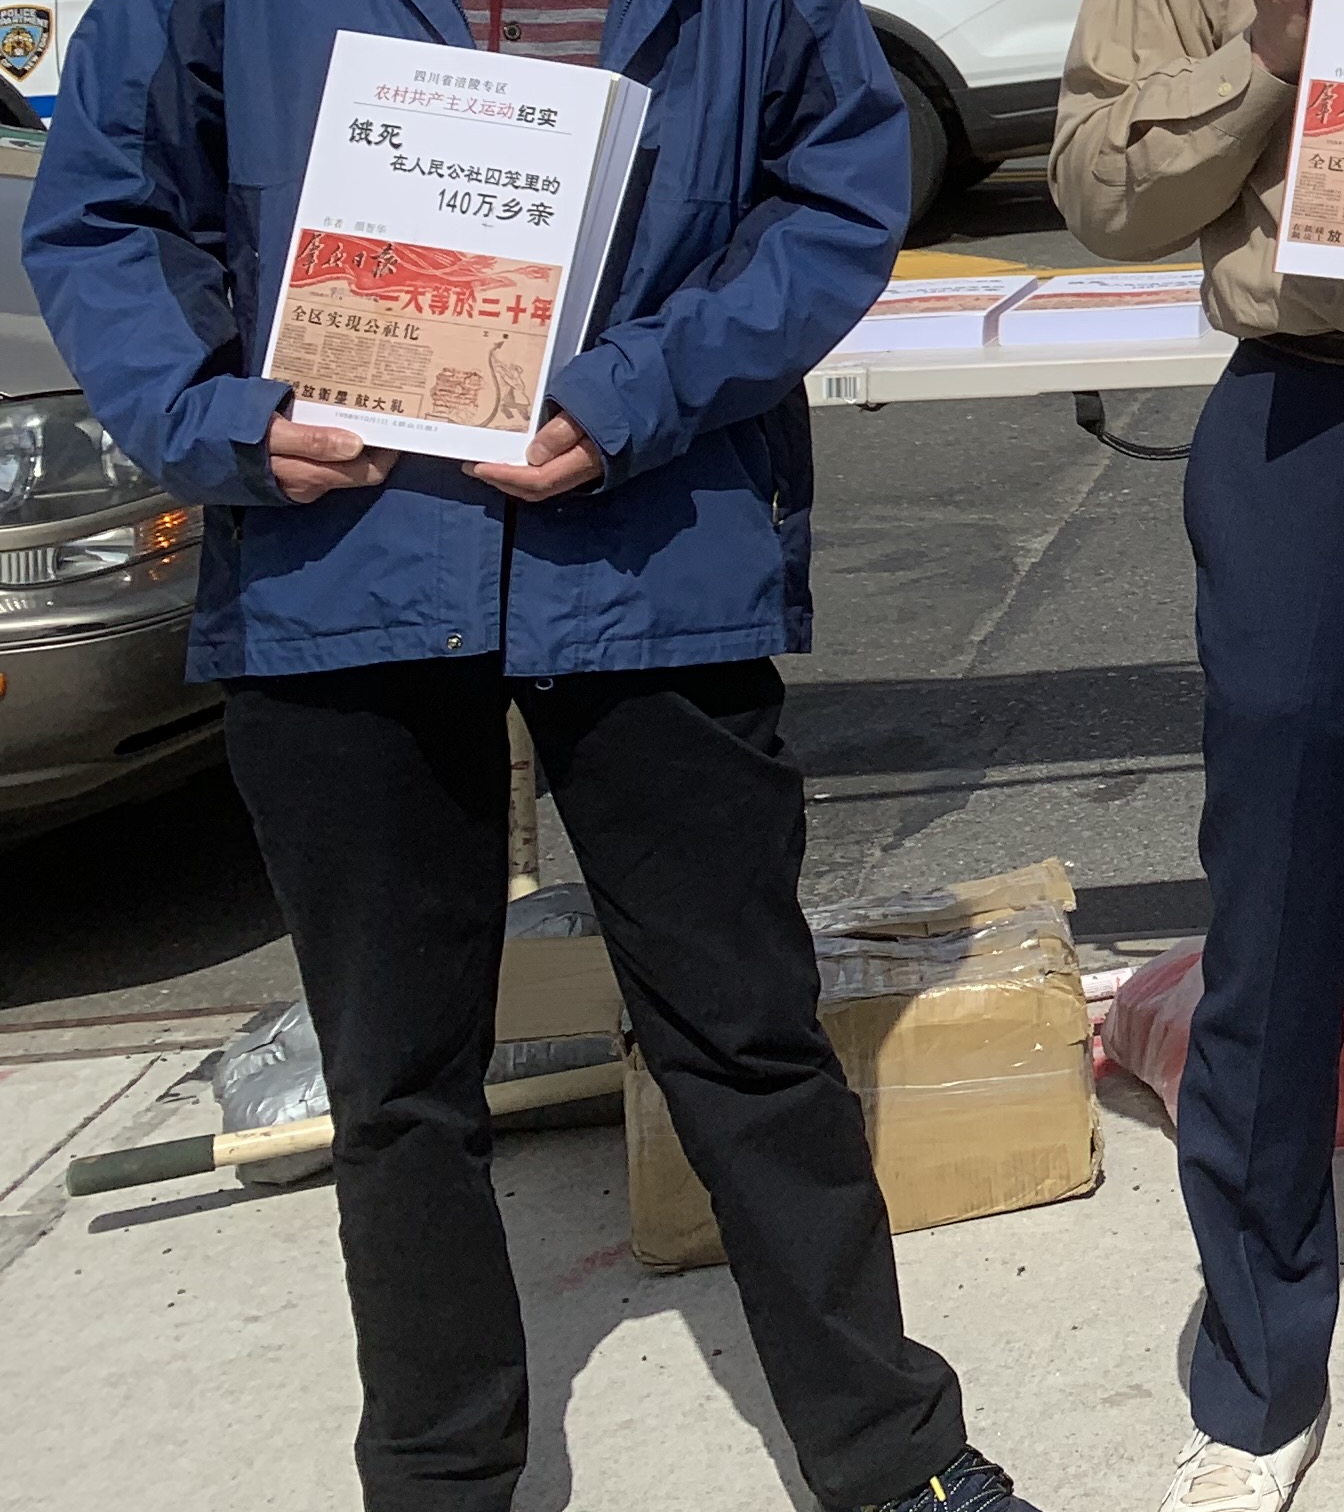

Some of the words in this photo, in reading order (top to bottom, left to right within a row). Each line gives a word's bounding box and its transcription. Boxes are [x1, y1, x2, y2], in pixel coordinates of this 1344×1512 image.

[374, 84, 558, 128] 农村共产主义运动纪实
[348, 117, 403, 150] 饿死
[390, 154, 561, 195] 在人民公社囚笼里的
[437, 189, 555, 227] 140万乡亲
